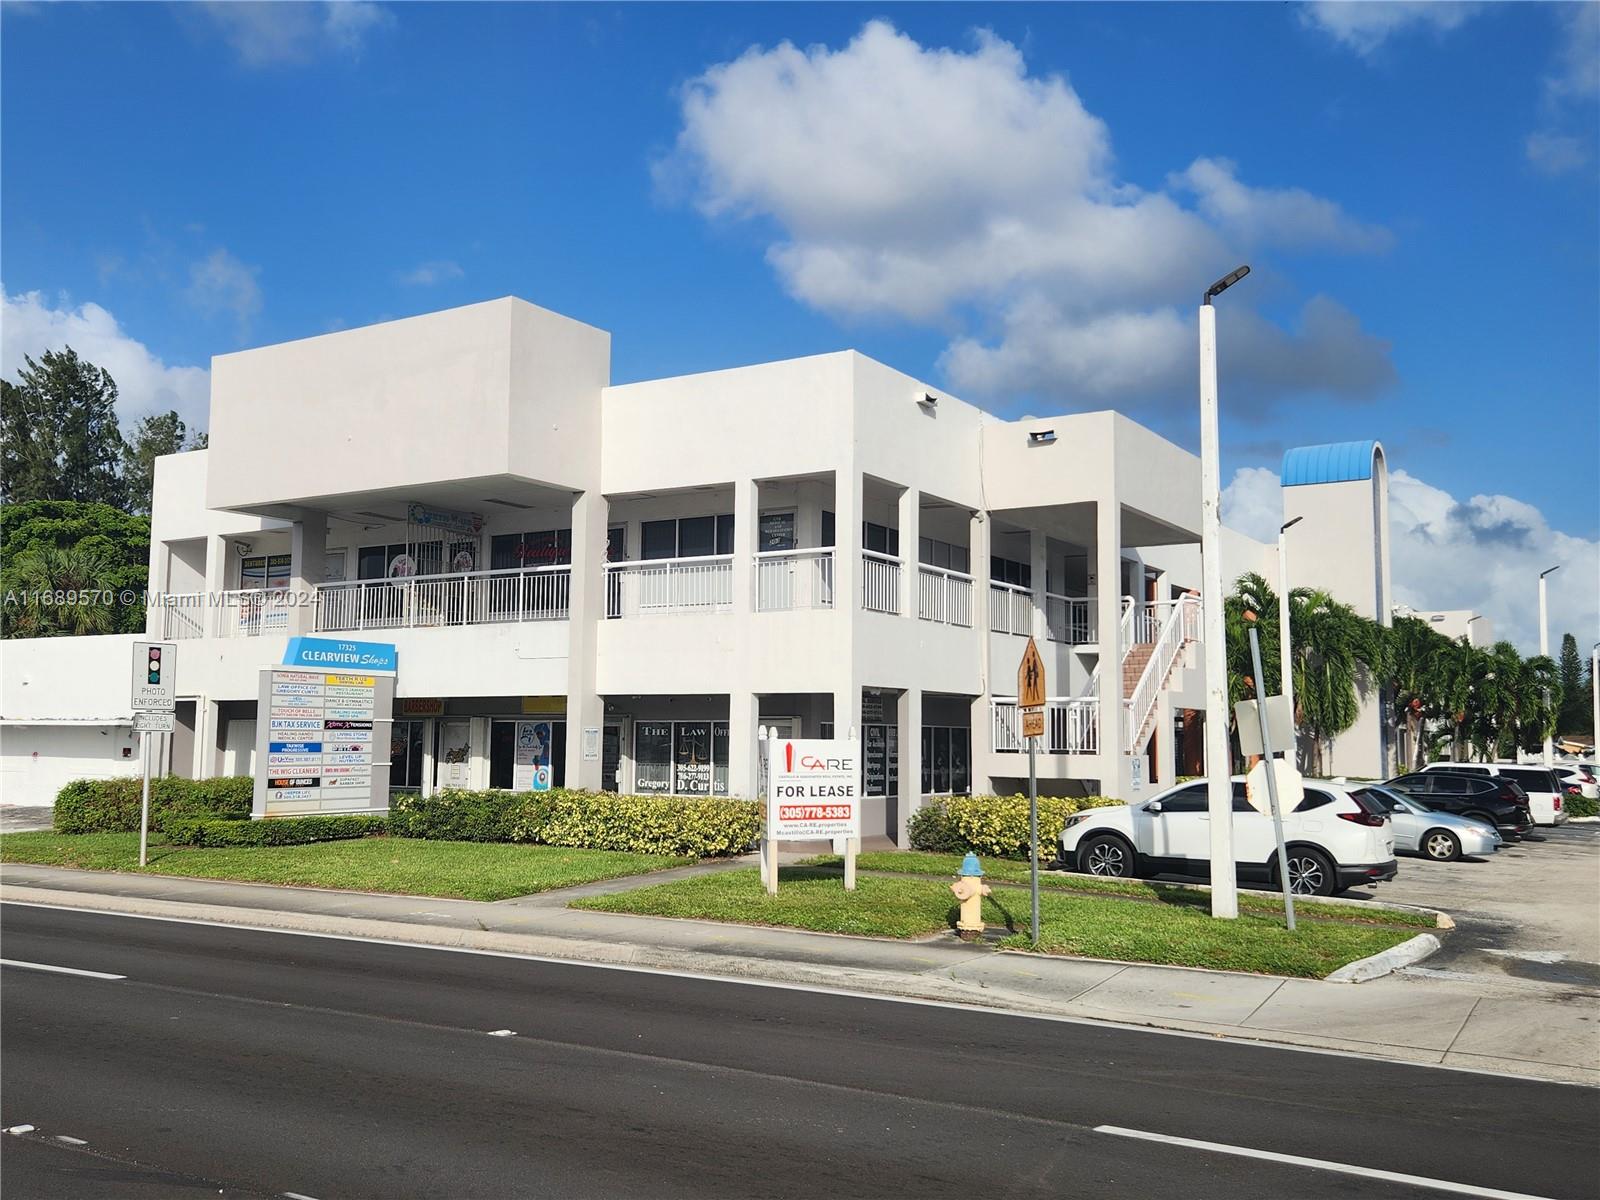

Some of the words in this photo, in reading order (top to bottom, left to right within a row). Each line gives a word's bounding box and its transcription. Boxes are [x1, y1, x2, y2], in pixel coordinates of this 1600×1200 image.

[302, 650, 360, 664] CLEARVIEW
[360, 654, 389, 667] Shops
[142, 688, 166, 696] PHOTO
[134, 698, 172, 707] ENFORCED
[284, 720, 296, 728] TAX
[297, 721, 321, 729] SERVICE
[642, 726, 669, 736] THE
[681, 727, 707, 736] LAW
[638, 779, 670, 789] Gregory
[677, 780, 688, 791] D.
[776, 786, 805, 797] FOR
[810, 785, 854, 797] LEASE
